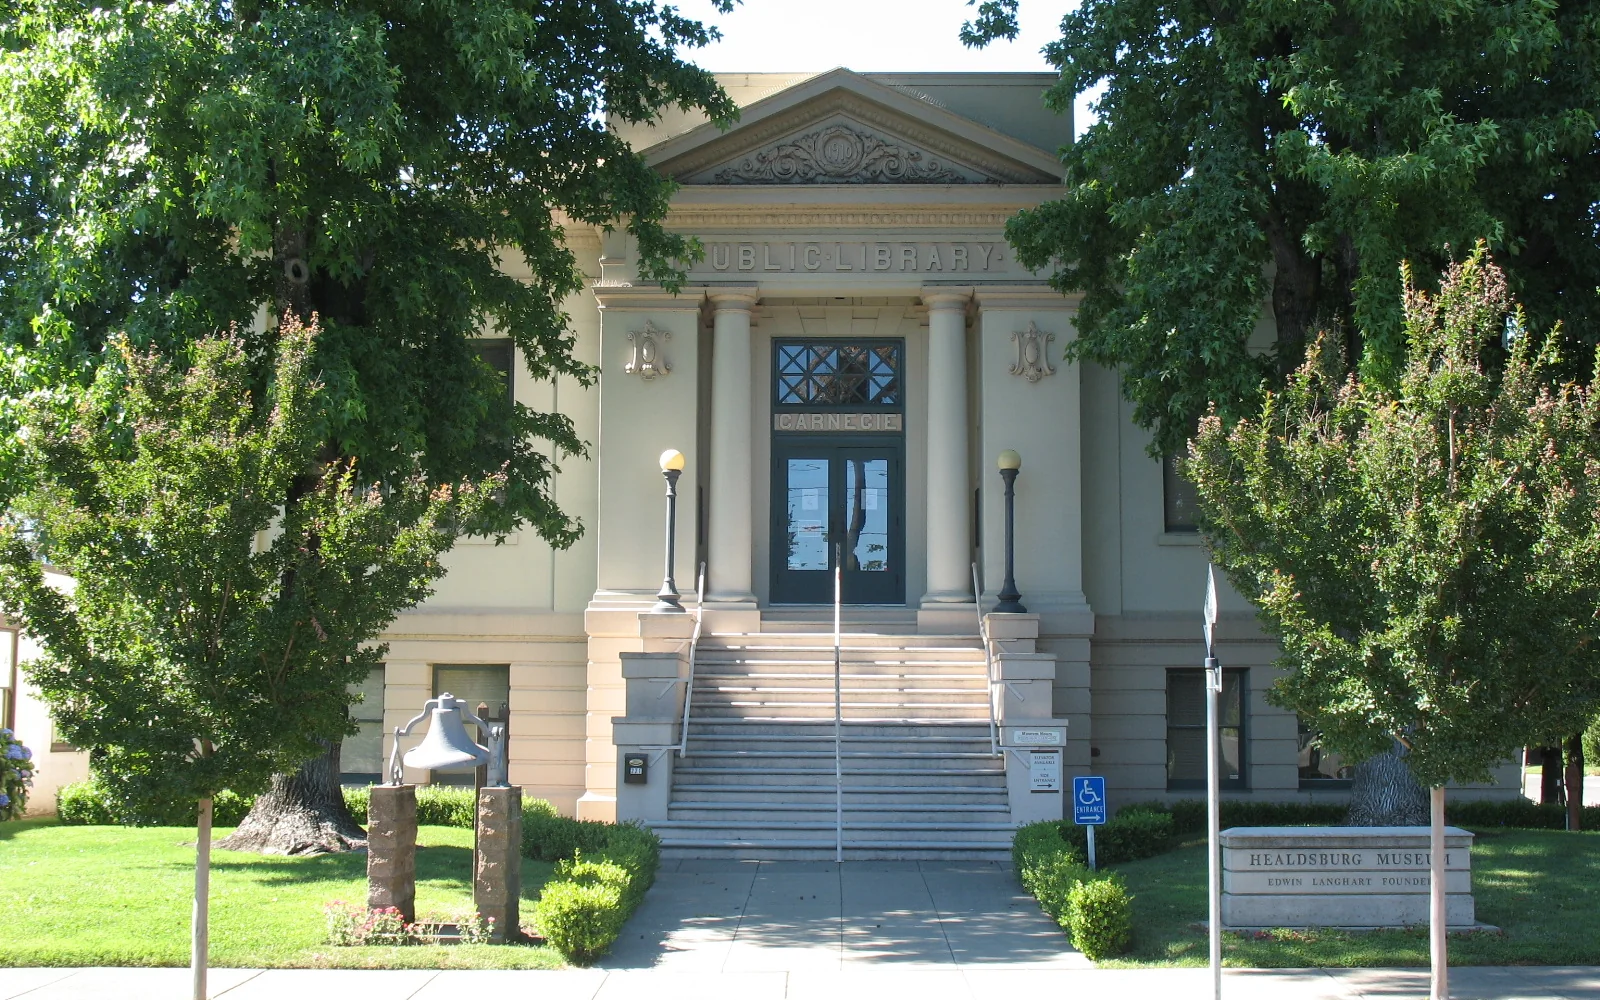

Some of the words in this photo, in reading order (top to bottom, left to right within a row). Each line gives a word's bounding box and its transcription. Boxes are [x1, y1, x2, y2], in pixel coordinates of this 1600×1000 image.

[828, 143, 852, 160] 1910
[687, 245, 821, 271] UBLIC
[835, 245, 994, 271] LIBRARY
[779, 413, 897, 430] CARNEGIE
[1077, 805, 1103, 813] ENTRANCE
[1250, 853, 1362, 866] HEALDSBURG
[1268, 878, 1302, 886] EDWIN
[1312, 878, 1372, 886] LANGHART
